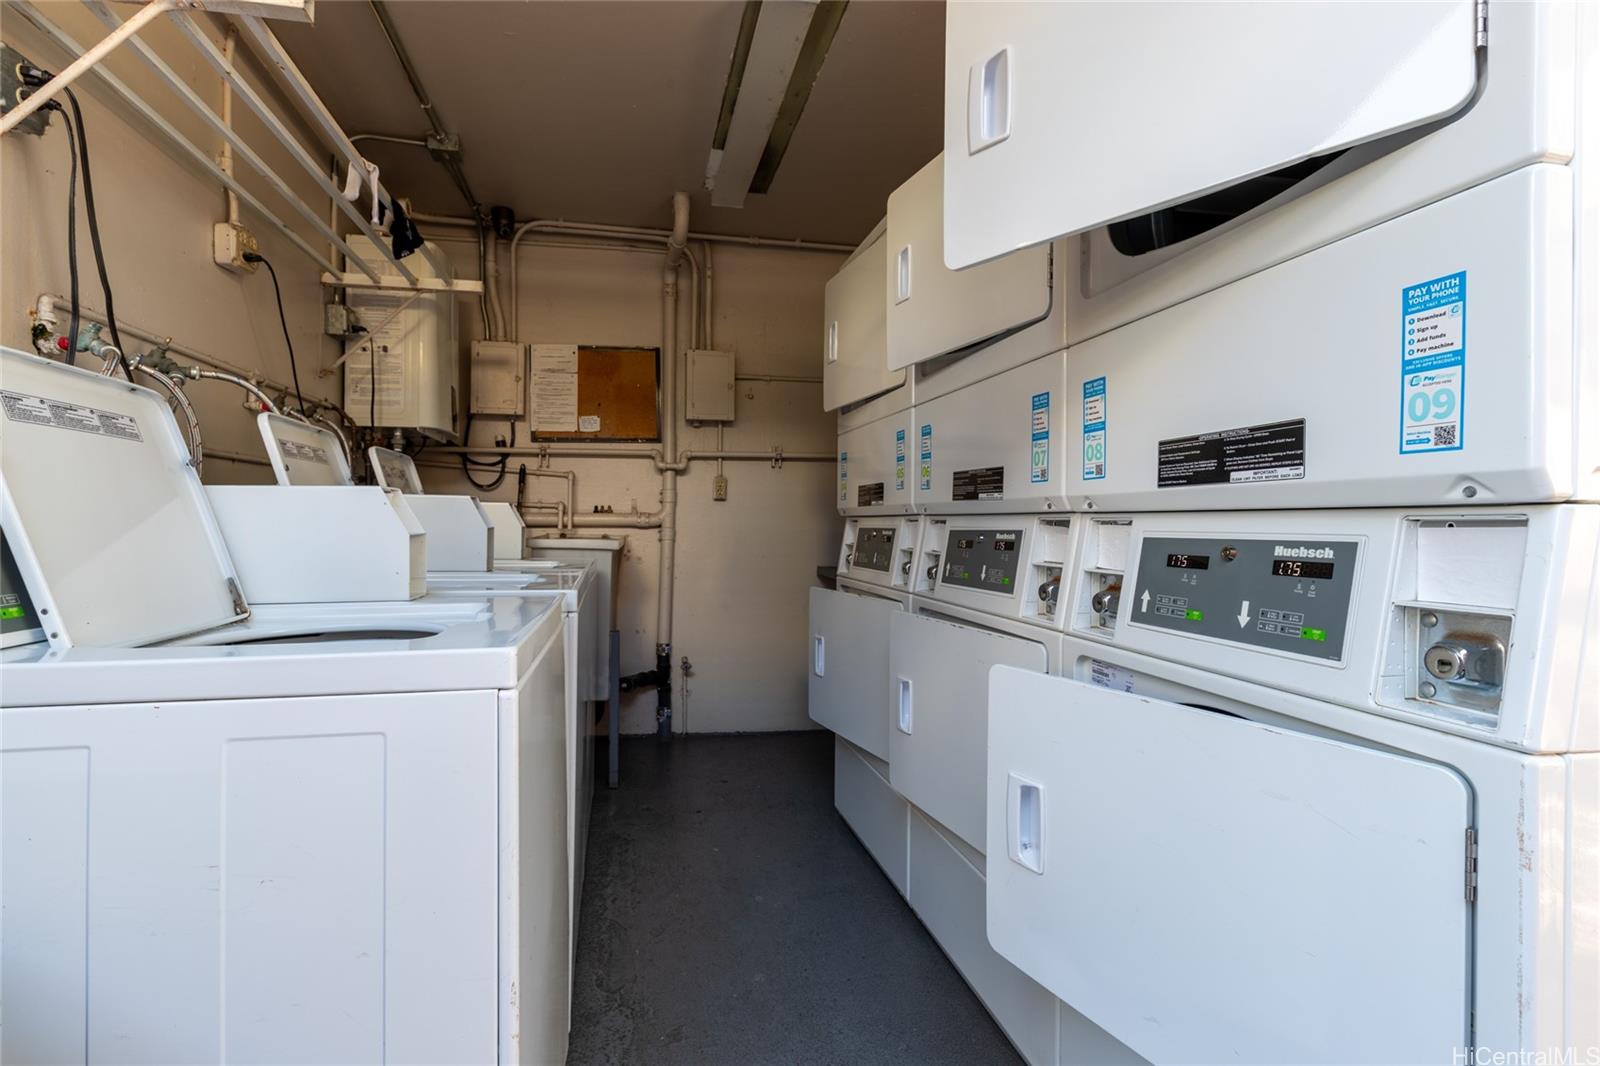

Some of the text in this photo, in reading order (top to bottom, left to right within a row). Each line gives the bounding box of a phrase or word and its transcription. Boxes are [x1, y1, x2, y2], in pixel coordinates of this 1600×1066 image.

[1408, 277, 1460, 299] PAY WITH
[1408, 286, 1459, 305] YOUR PHONE
[1416, 311, 1447, 323] Download
[1428, 342, 1454, 351] machine
[1408, 388, 1456, 422] 09
[1034, 450, 1046, 467] 07
[1086, 443, 1103, 462] 08
[1274, 545, 1334, 558] Huebsch
